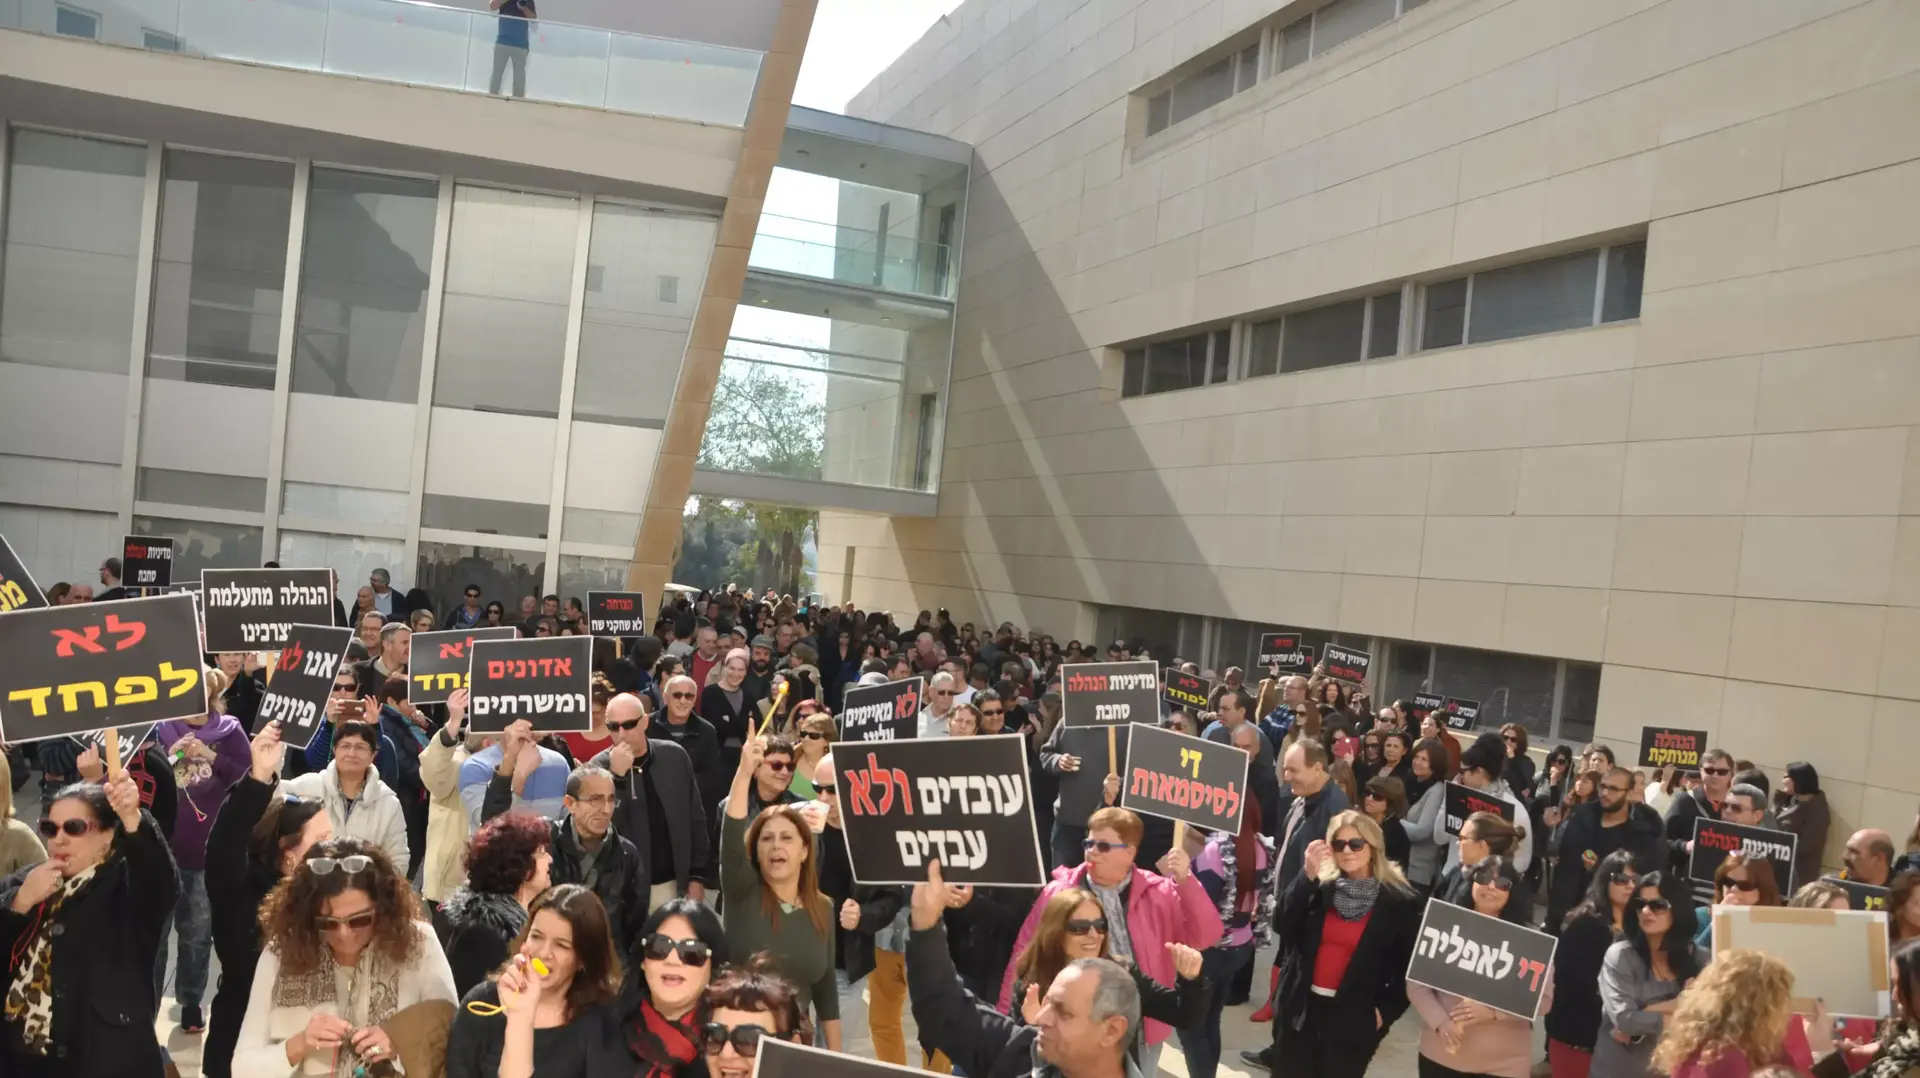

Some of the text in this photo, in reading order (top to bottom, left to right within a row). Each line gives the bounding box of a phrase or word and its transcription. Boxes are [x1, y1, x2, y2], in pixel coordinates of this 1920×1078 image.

[147, 546, 171, 560] מדיניות
[138, 569, 157, 583] סחבת
[209, 581, 273, 608] מתעלמת
[280, 580, 328, 606] הנהלה
[51, 613, 147, 658] לא
[591, 616, 643, 635] לא שחקני שח
[439, 635, 474, 659] א
[276, 640, 338, 680] אנו לא
[487, 657, 573, 680] אדונים
[8, 661, 198, 717] לפחד
[413, 671, 471, 691] חד
[1068, 672, 1156, 692] מדיניות הנהלה
[1179, 677, 1200, 689] לא
[473, 693, 586, 715] ומשרתים
[845, 684, 917, 728] לא מאיימים
[1167, 687, 1208, 706] לפחד
[260, 692, 317, 728] פיונים
[1095, 703, 1130, 720] סחבת
[1654, 729, 1697, 751] הנהלה
[1180, 746, 1203, 779] די
[1647, 747, 1699, 767] מנותקת
[844, 752, 1024, 817] עובדים ולא
[1130, 767, 1240, 819] לסיסמאות
[895, 829, 988, 871] עבדים
[1700, 827, 1791, 862] מדיניות הנהלה
[1418, 924, 1546, 993] די לאפליה
